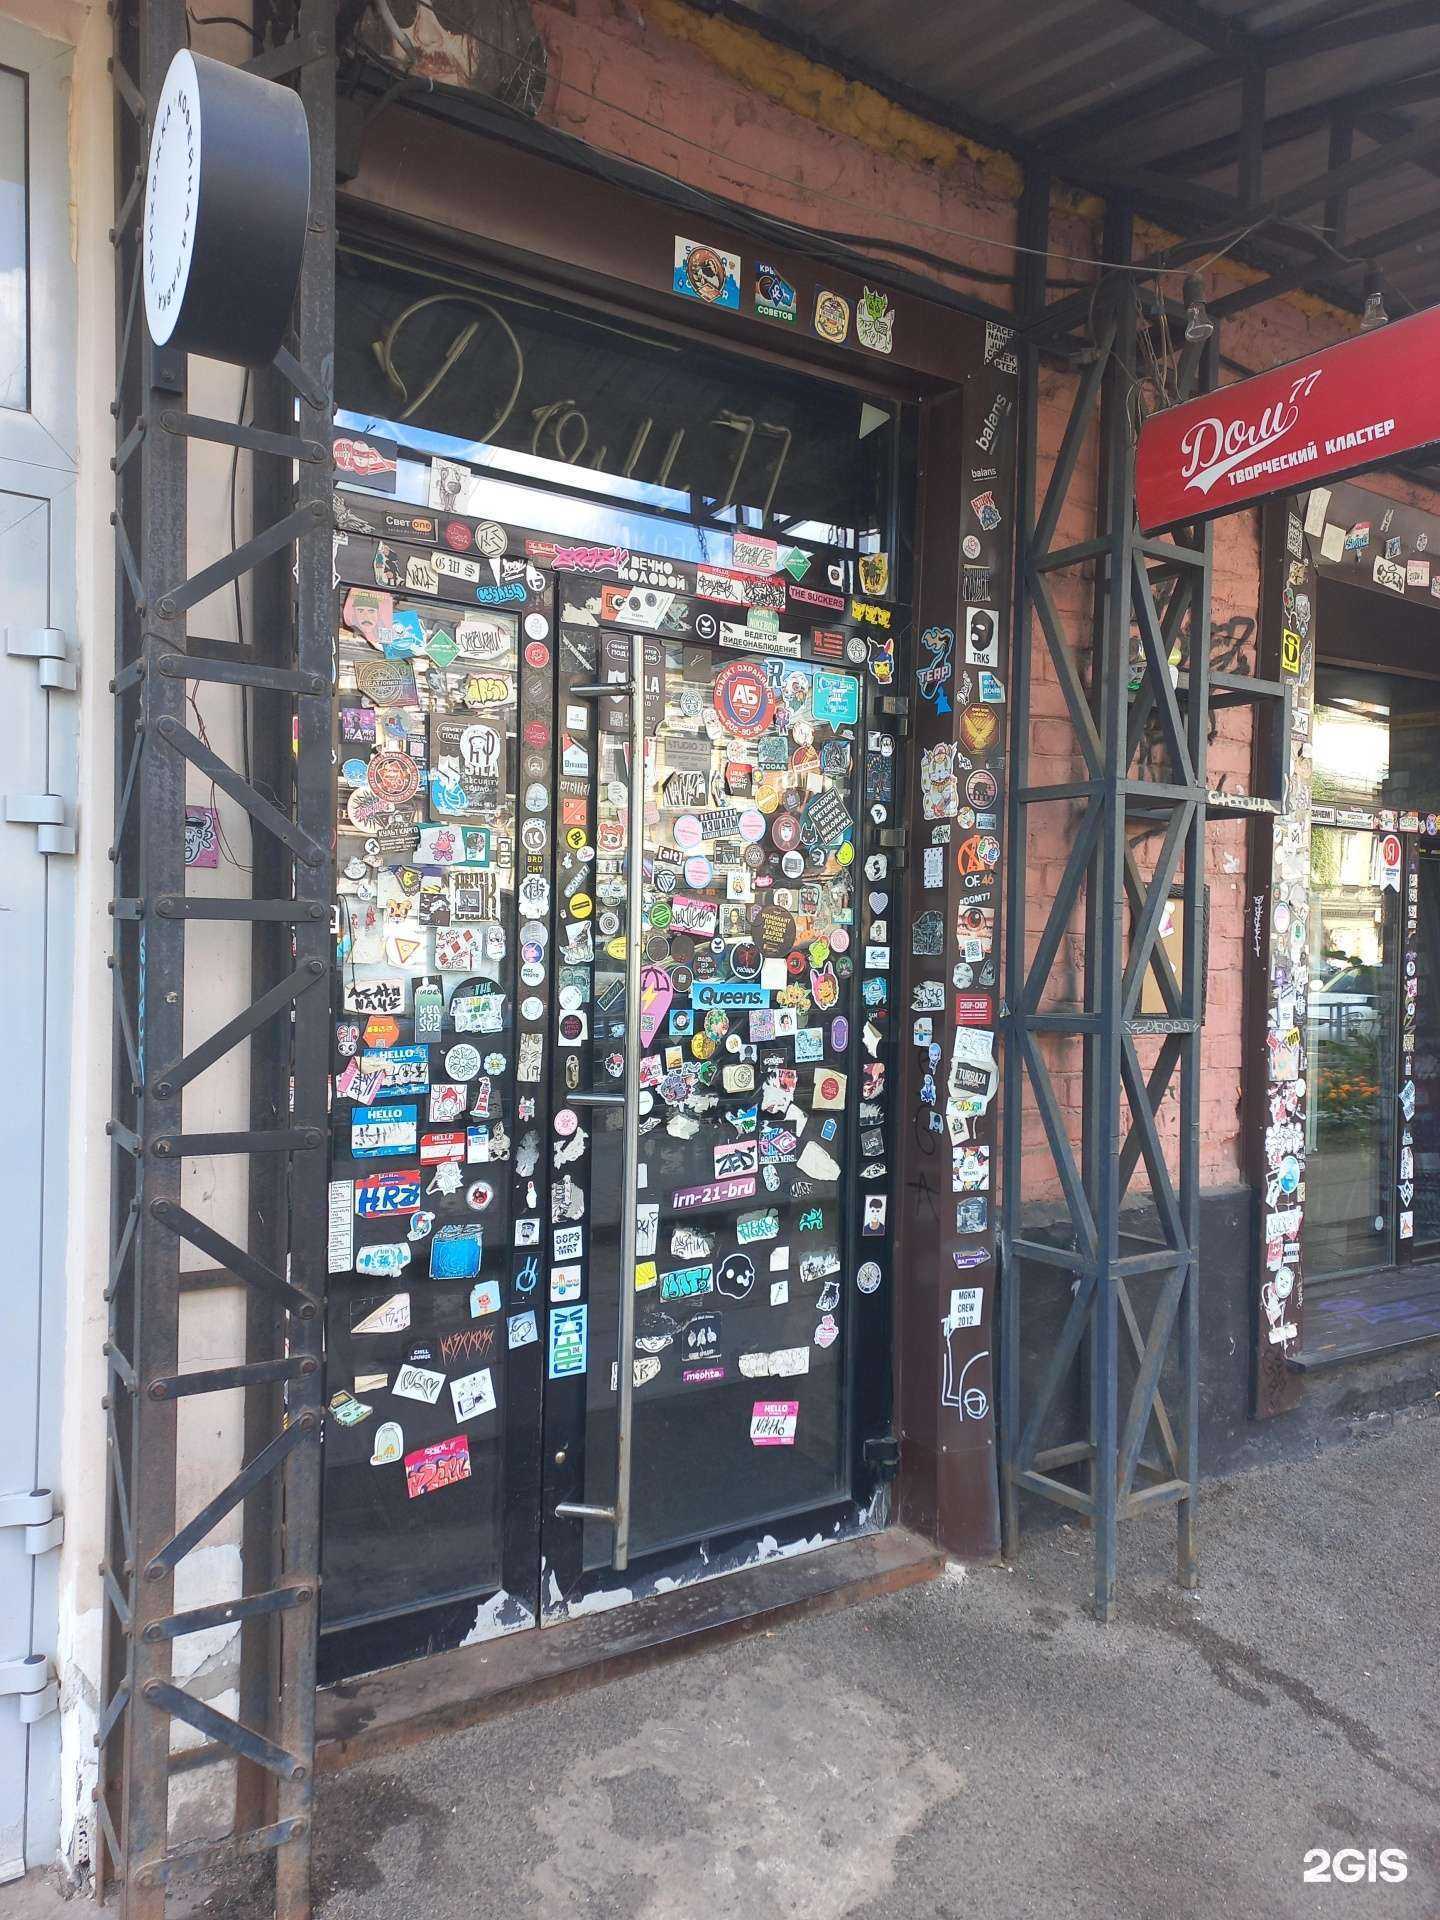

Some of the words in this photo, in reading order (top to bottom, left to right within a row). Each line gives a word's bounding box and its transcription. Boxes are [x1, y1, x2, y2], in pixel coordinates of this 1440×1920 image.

[757, 304, 794, 321] СОВЕТОВ
[975, 393, 1008, 453] balans
[1181, 402, 1299, 478] Дом
[1288, 369, 1323, 404] 77
[1227, 442, 1319, 487] ТВОРЧЕСКИЙ
[1324, 418, 1396, 456] КЛАСТЕР
[970, 466, 998, 481] balans
[385, 515, 412, 528] Свет
[413, 520, 431, 531] one
[630, 555, 674, 575] ВЕЧНО
[617, 567, 687, 591] МОЛОДОЙ
[790, 586, 806, 599] THE
[807, 590, 844, 608] SUCKERS
[722, 635, 799, 655] ВИДЕОНАБЛЮДЕНИЕ
[744, 629, 778, 642] ВЕДЕТСЯ
[972, 651, 991, 665] TRKS
[715, 667, 737, 698] ОБЪЕКТ
[732, 684, 759, 705] АБ
[808, 791, 836, 816] MOLODOY
[813, 799, 841, 825] VETEROK
[820, 808, 841, 829] BORYA
[821, 813, 848, 837] MILORAD
[823, 818, 852, 844] PROLIVKA
[761, 912, 791, 925] НОМИНАНТ
[700, 986, 764, 1007] Queens.
[378, 1049, 413, 1059] HELLO
[367, 1108, 403, 1119] HELLO
[431, 1133, 455, 1143] HELLO
[672, 1181, 756, 1209] irn-21-bru
[958, 1289, 977, 1301] MGKA
[957, 1301, 976, 1313] CREW
[957, 1314, 974, 1327] 2012
[763, 1403, 789, 1414] HELLO
